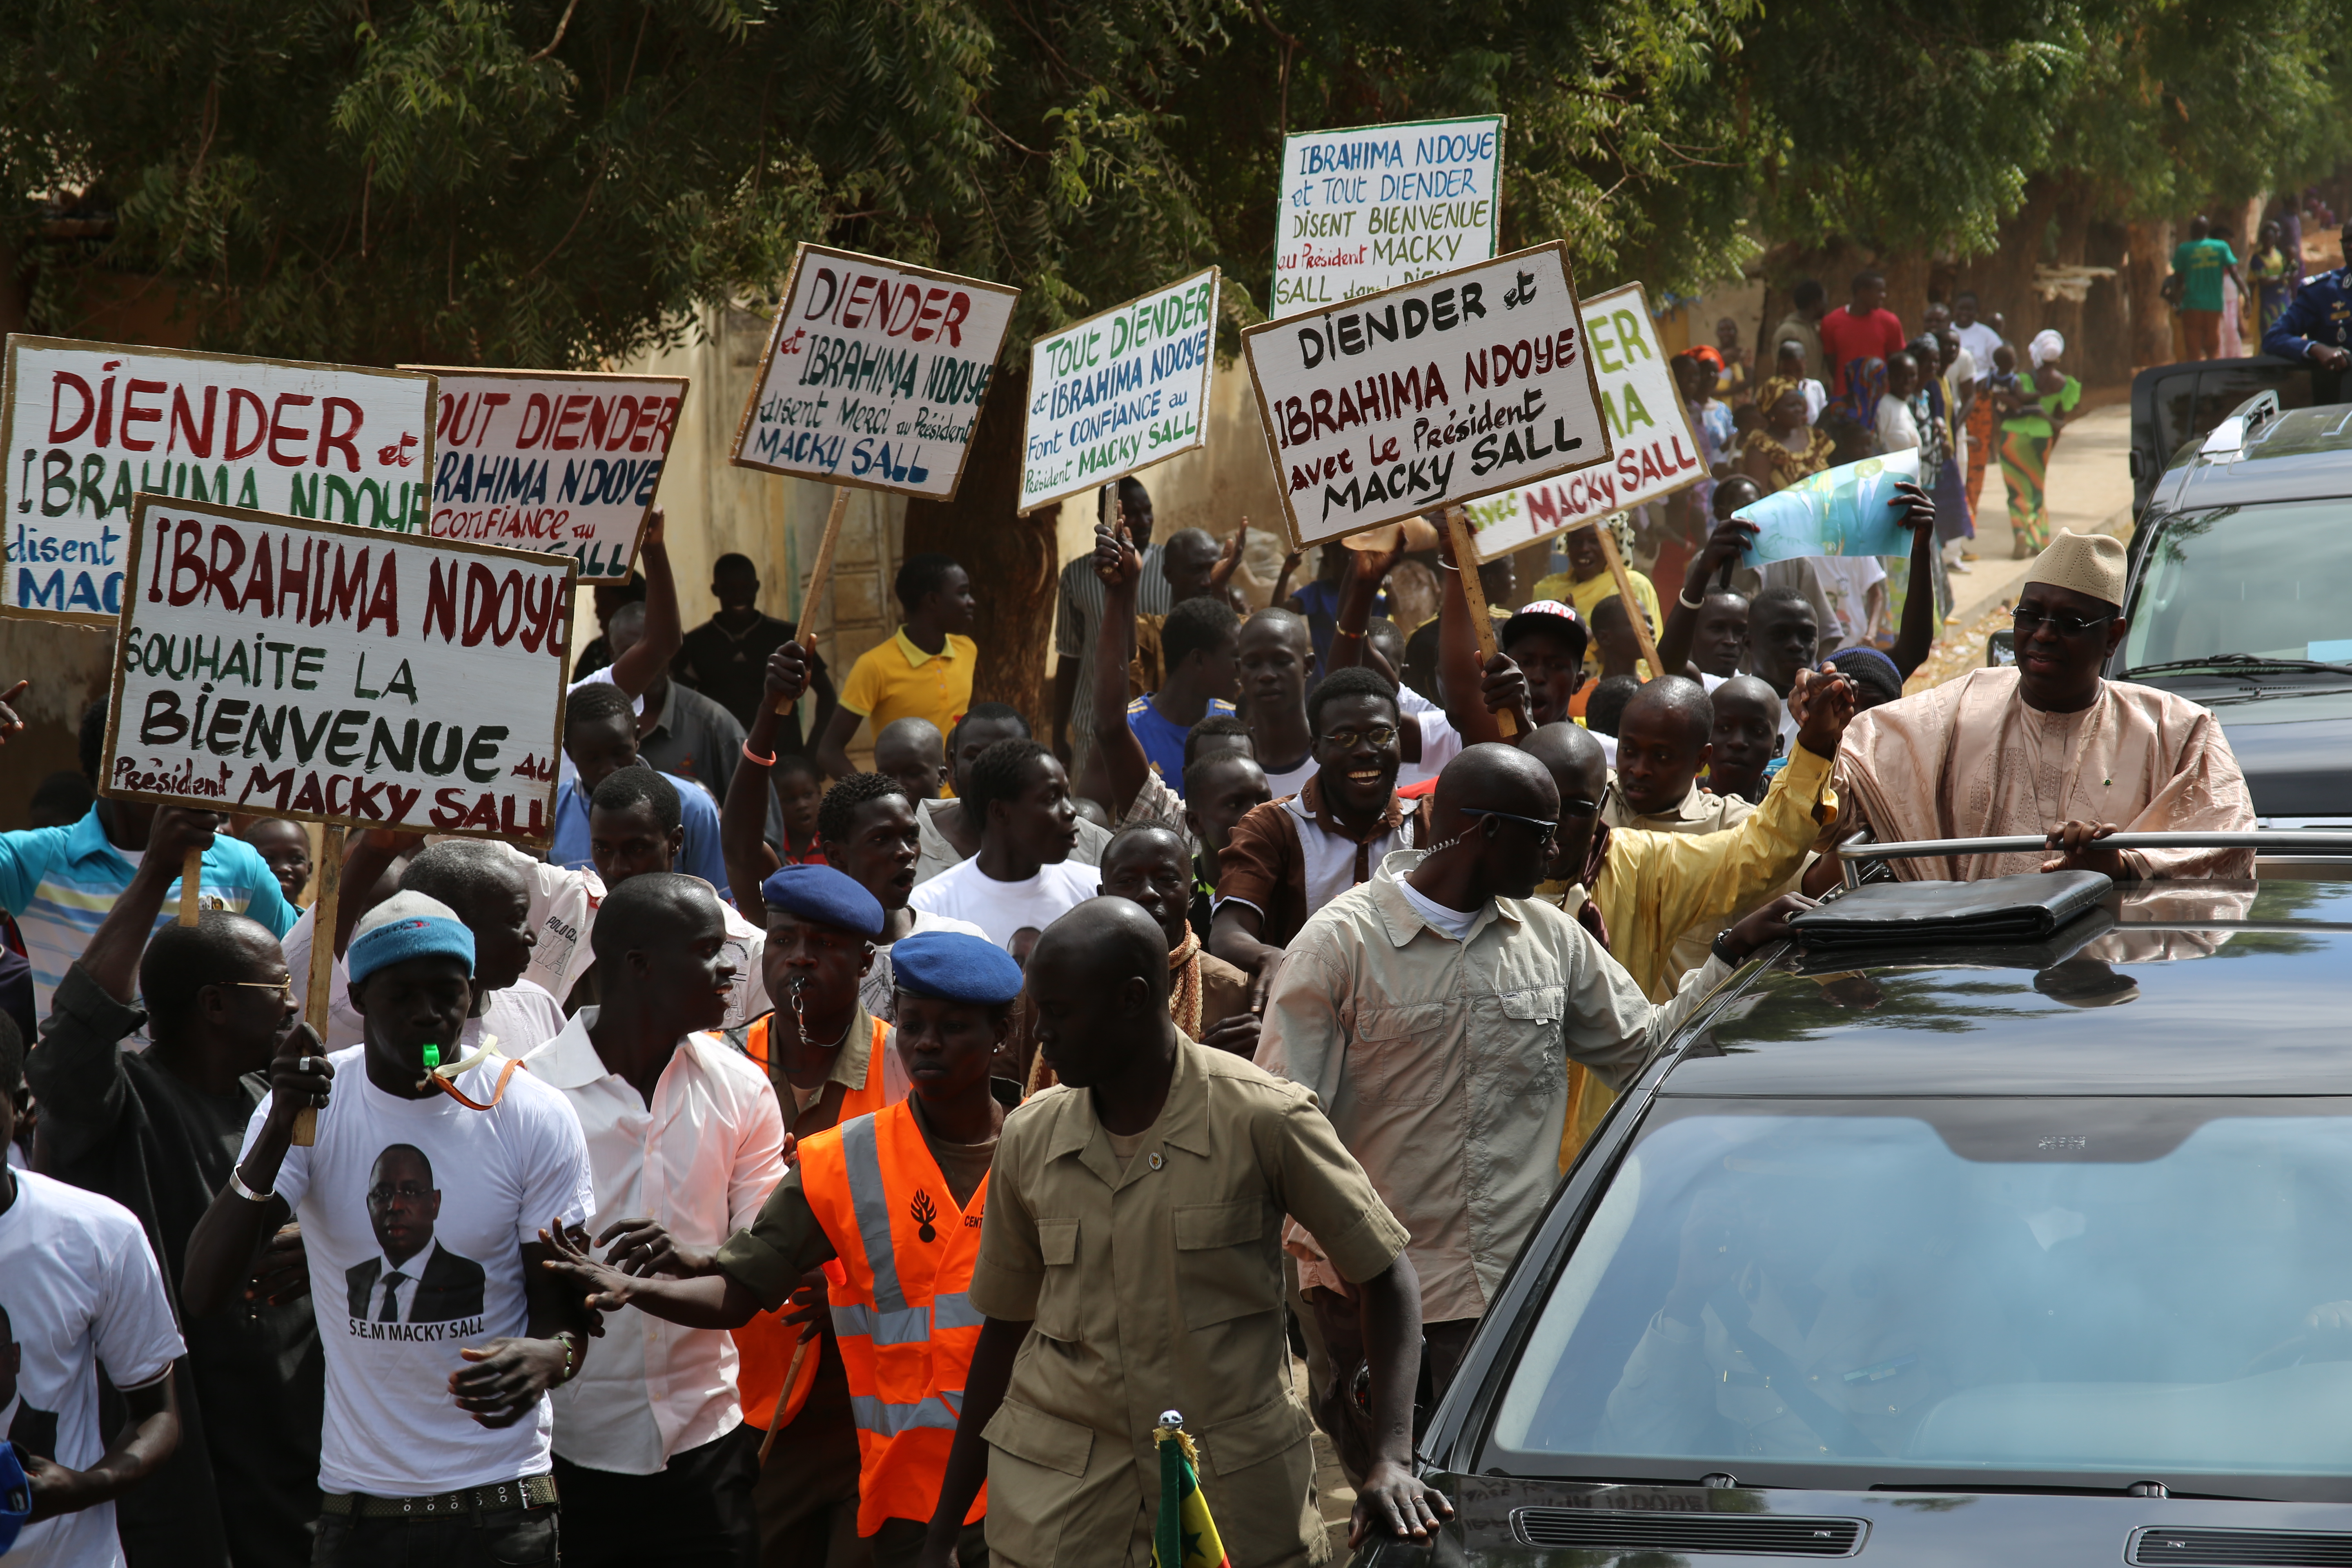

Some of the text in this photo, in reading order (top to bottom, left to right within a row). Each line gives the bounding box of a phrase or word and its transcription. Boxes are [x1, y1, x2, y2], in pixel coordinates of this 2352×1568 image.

[1300, 132, 1494, 175] IBRAHIMA NDOYE
[1292, 180, 1313, 207] et
[1381, 168, 1477, 202] DIENDER
[1368, 200, 1489, 235] BIENVENUE
[1277, 252, 1296, 271] au
[1373, 233, 1462, 265] MACKY
[804, 267, 970, 348] DIENDER
[1276, 275, 1332, 305] SALL
[1503, 270, 1537, 310] et
[781, 327, 996, 406] et IBRAHIMA NDOYE
[1032, 391, 1048, 414] et
[1150, 329, 1208, 384] NDOYE
[1274, 327, 1576, 449] IBRAHIMA NDOYE
[437, 391, 681, 452] OUT DIENDER
[760, 390, 829, 428] disent
[1028, 429, 1063, 461] Font
[1169, 390, 1187, 408] au
[377, 432, 421, 468] et
[754, 427, 929, 483] MACKY SALL
[1078, 430, 1143, 477] MACKY
[1148, 411, 1196, 449] SALL
[1323, 417, 1582, 523] MACKY SALL
[434, 450, 662, 506] RAHIMA NDOYE
[1525, 470, 1618, 534] MACKY
[1617, 435, 1696, 492] SALL
[6, 525, 121, 564] disent
[572, 523, 595, 540] au
[148, 517, 572, 657] IBRAHIMA NDOYE
[354, 652, 418, 706] LA
[238, 762, 421, 830] MACKY
[429, 788, 546, 837] SALL
[546, 916, 568, 935] POLO
[349, 1317, 484, 1341] S.E.M MACKY SALL
